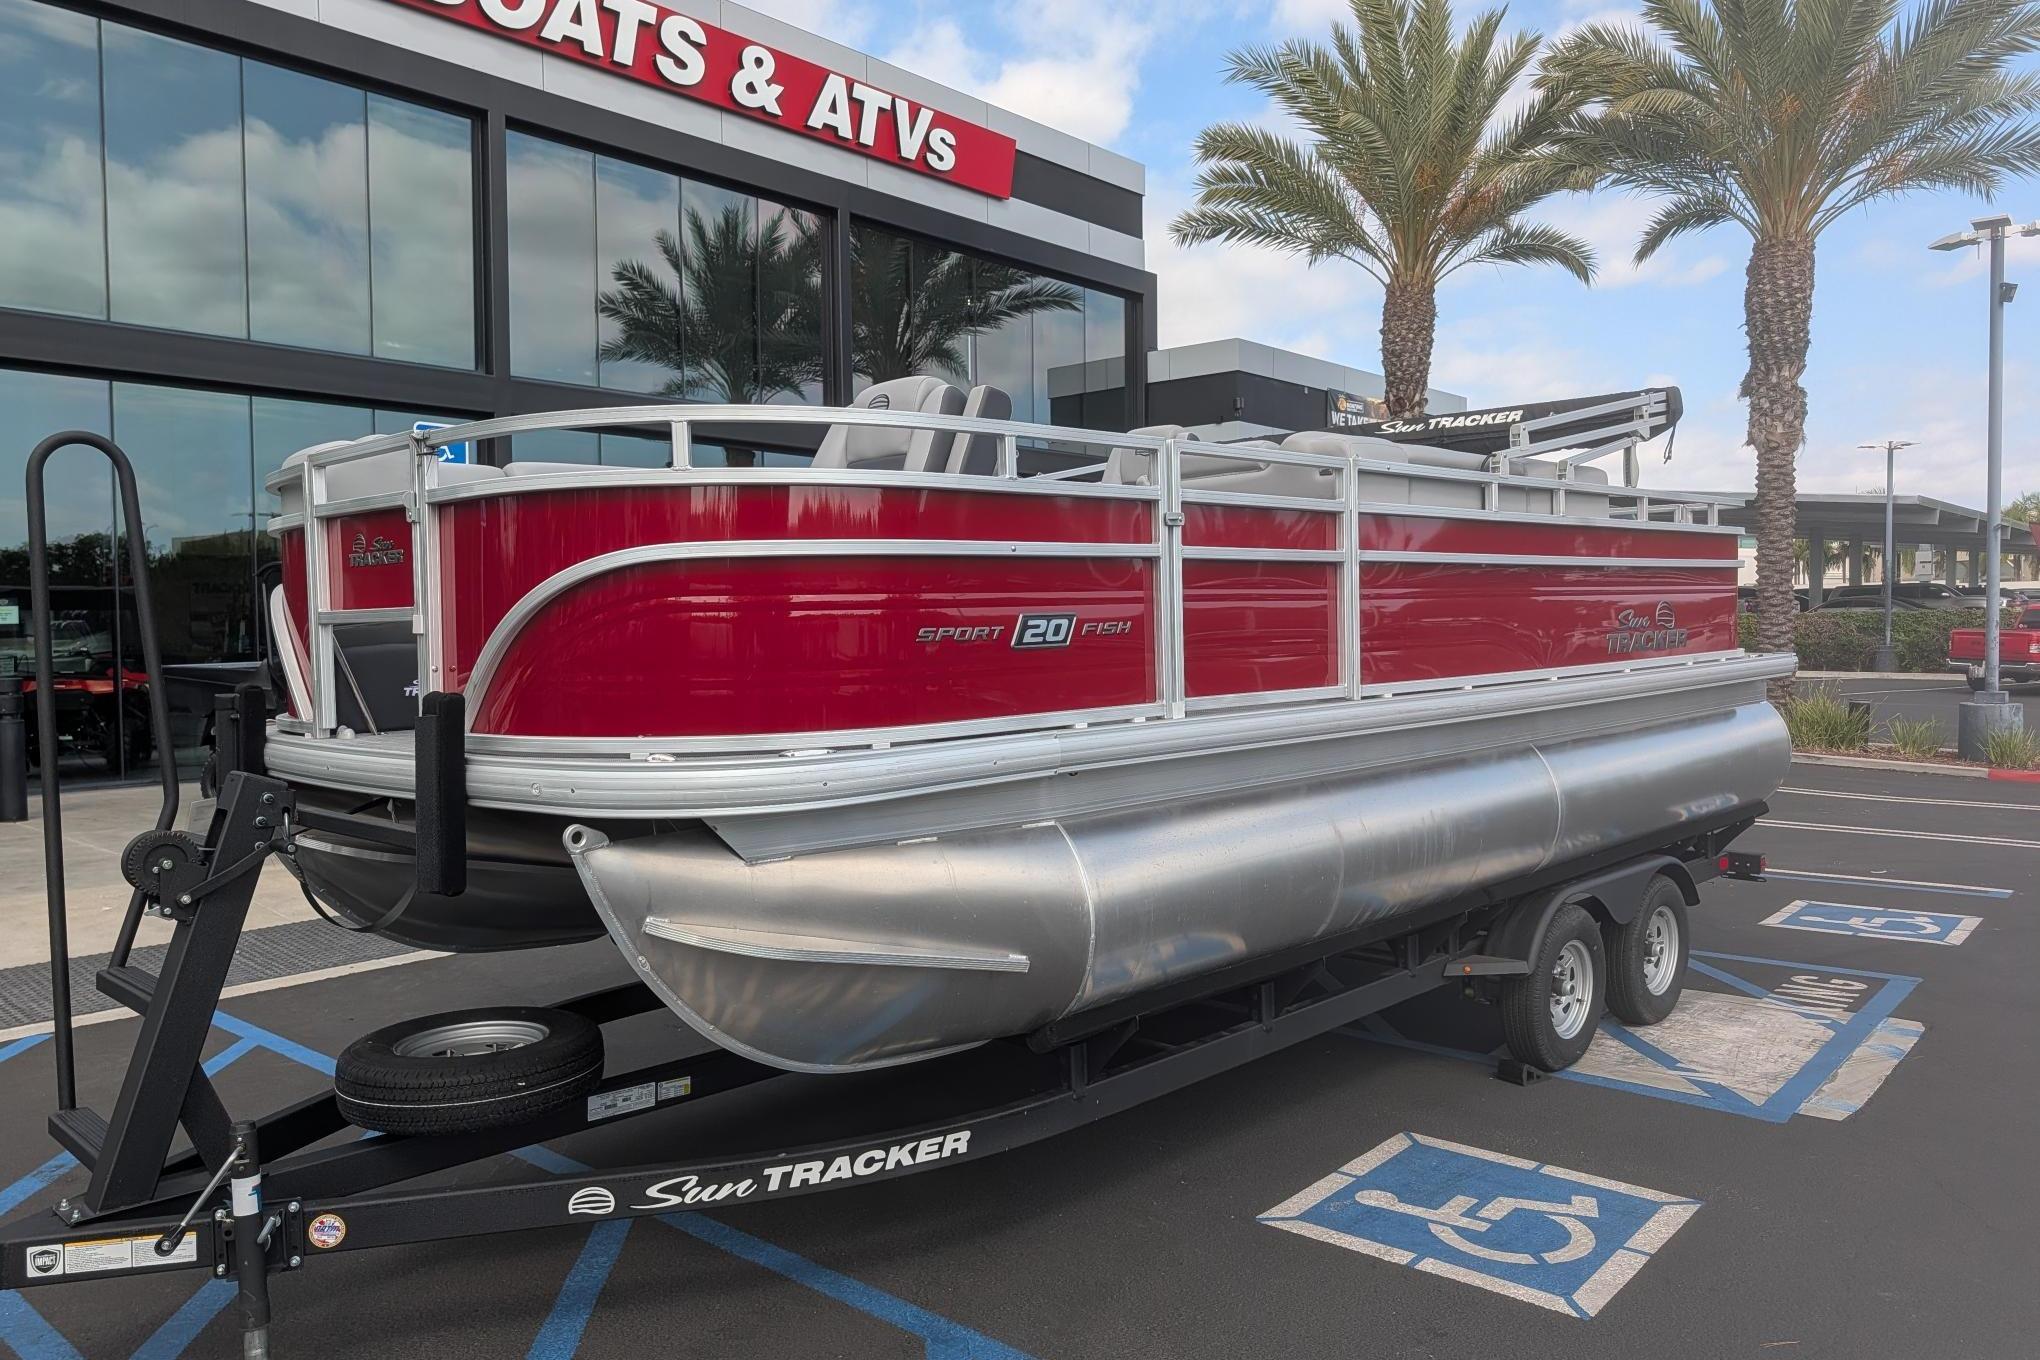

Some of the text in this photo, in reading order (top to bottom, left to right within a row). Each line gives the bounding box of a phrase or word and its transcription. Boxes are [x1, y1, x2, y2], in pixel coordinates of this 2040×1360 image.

[433, 0, 956, 172] ATS & ATVs
[1331, 410, 1346, 427] WE
[1374, 409, 1524, 434] Sun TRACKER
[349, 549, 404, 567] TRACKER
[1618, 609, 1650, 628] Sun
[915, 619, 1132, 643] SPORT 20 FISH
[1607, 629, 1687, 654] TRACKER
[629, 1130, 972, 1209] Sun TRACKER
